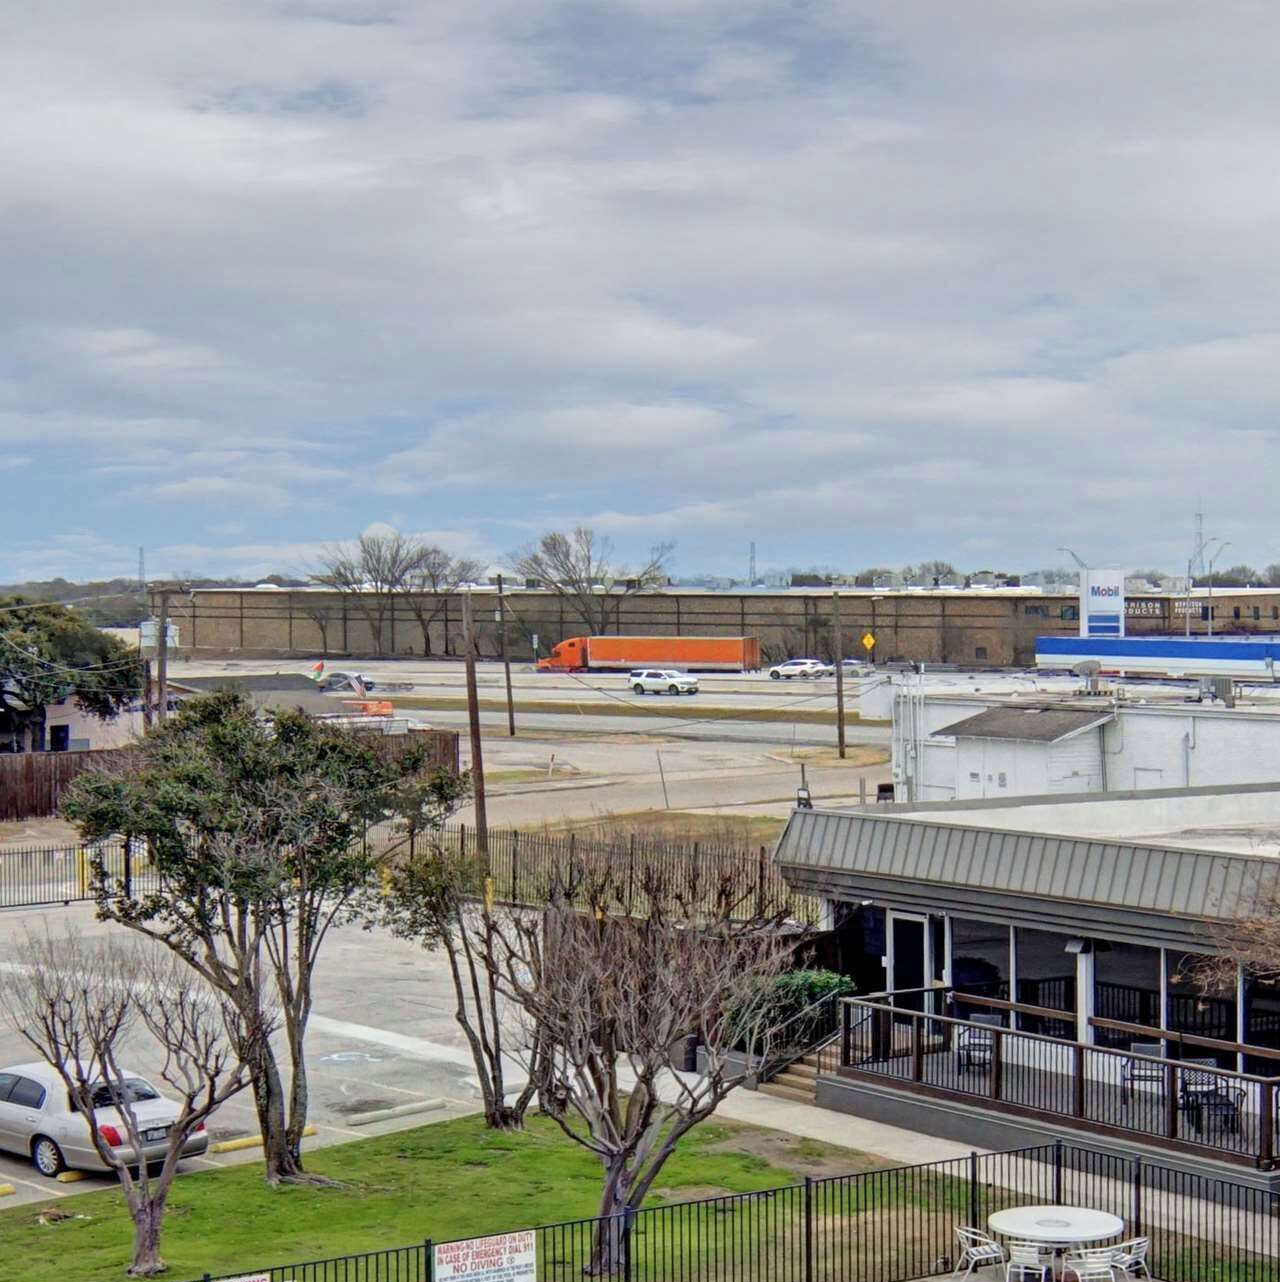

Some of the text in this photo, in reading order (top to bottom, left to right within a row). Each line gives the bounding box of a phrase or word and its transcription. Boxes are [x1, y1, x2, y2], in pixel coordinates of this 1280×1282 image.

[1091, 585, 1119, 597] Mobil
[518, 1231, 533, 1243] DUTY
[444, 1253, 461, 1264] CASE
[462, 1252, 470, 1262] OF
[471, 1247, 507, 1260] EMERGENCY
[453, 1257, 504, 1274] NO DIVING
